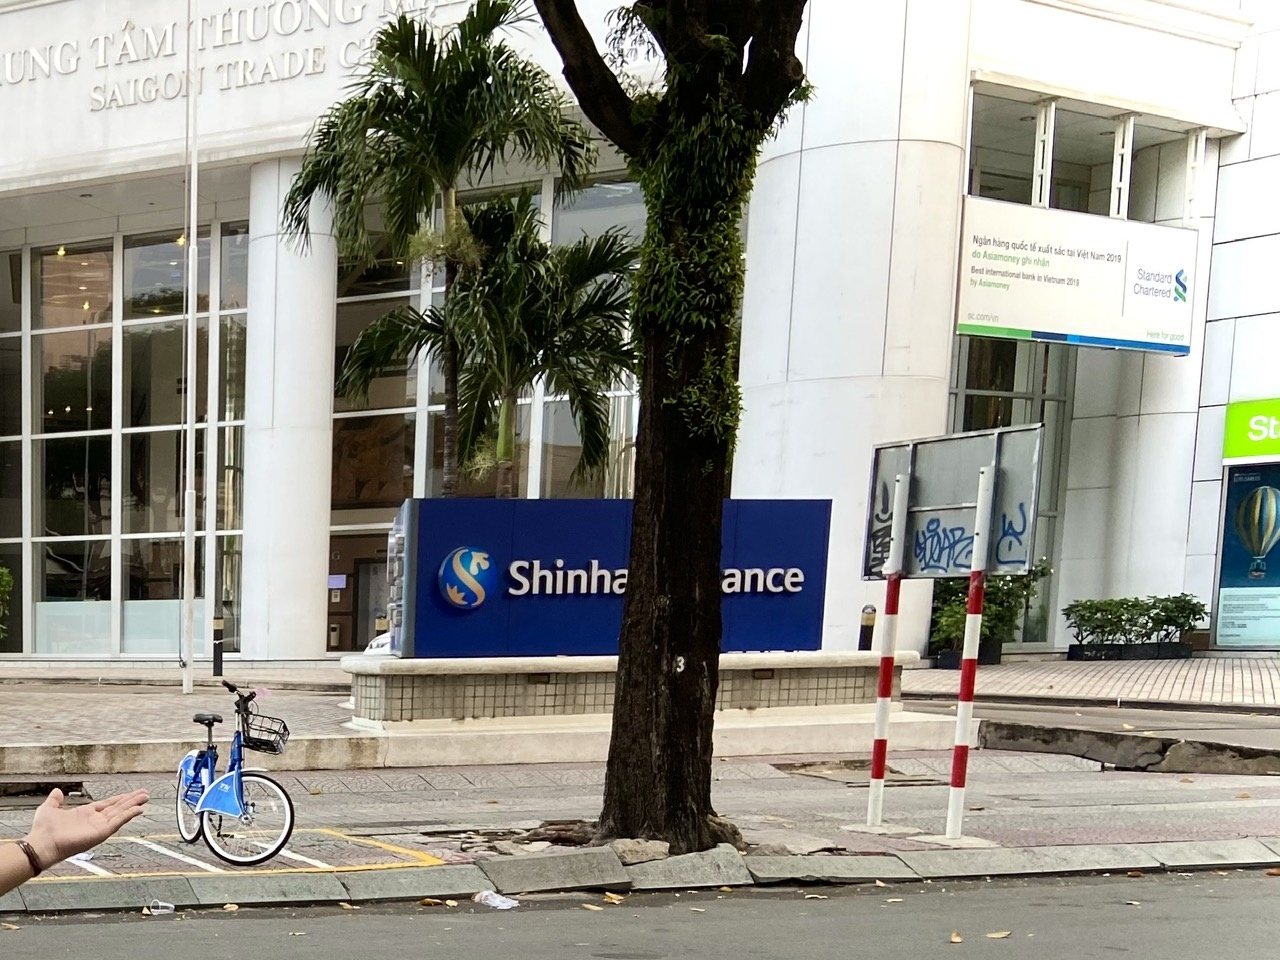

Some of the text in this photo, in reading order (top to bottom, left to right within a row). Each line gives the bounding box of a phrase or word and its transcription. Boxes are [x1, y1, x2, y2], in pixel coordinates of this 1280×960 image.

[90, 20, 177, 69] TÂM
[90, 66, 206, 112] SAIGON
[216, 46, 326, 91] TRADE
[972, 249, 982, 258] do
[983, 250, 1021, 265] Asiamoney
[1021, 256, 1032, 266] ghi
[1077, 248, 1090, 260] Việt
[1090, 251, 1106, 261] Nam
[1106, 252, 1122, 263] 2019
[971, 265, 985, 275] Best
[985, 267, 1021, 279] international
[1022, 271, 1036, 281] bank
[1037, 274, 1043, 282] in
[1043, 274, 1066, 285] Vietnam
[1137, 268, 1173, 284] Standard
[970, 277, 1010, 291] by Asiamoney
[1133, 283, 1171, 299] Chartered
[1146, 330, 1184, 342] Here for good
[1248, 414, 1280, 441] St
[508, 558, 805, 596] Shinha ance
[676, 656, 685, 673] 3
